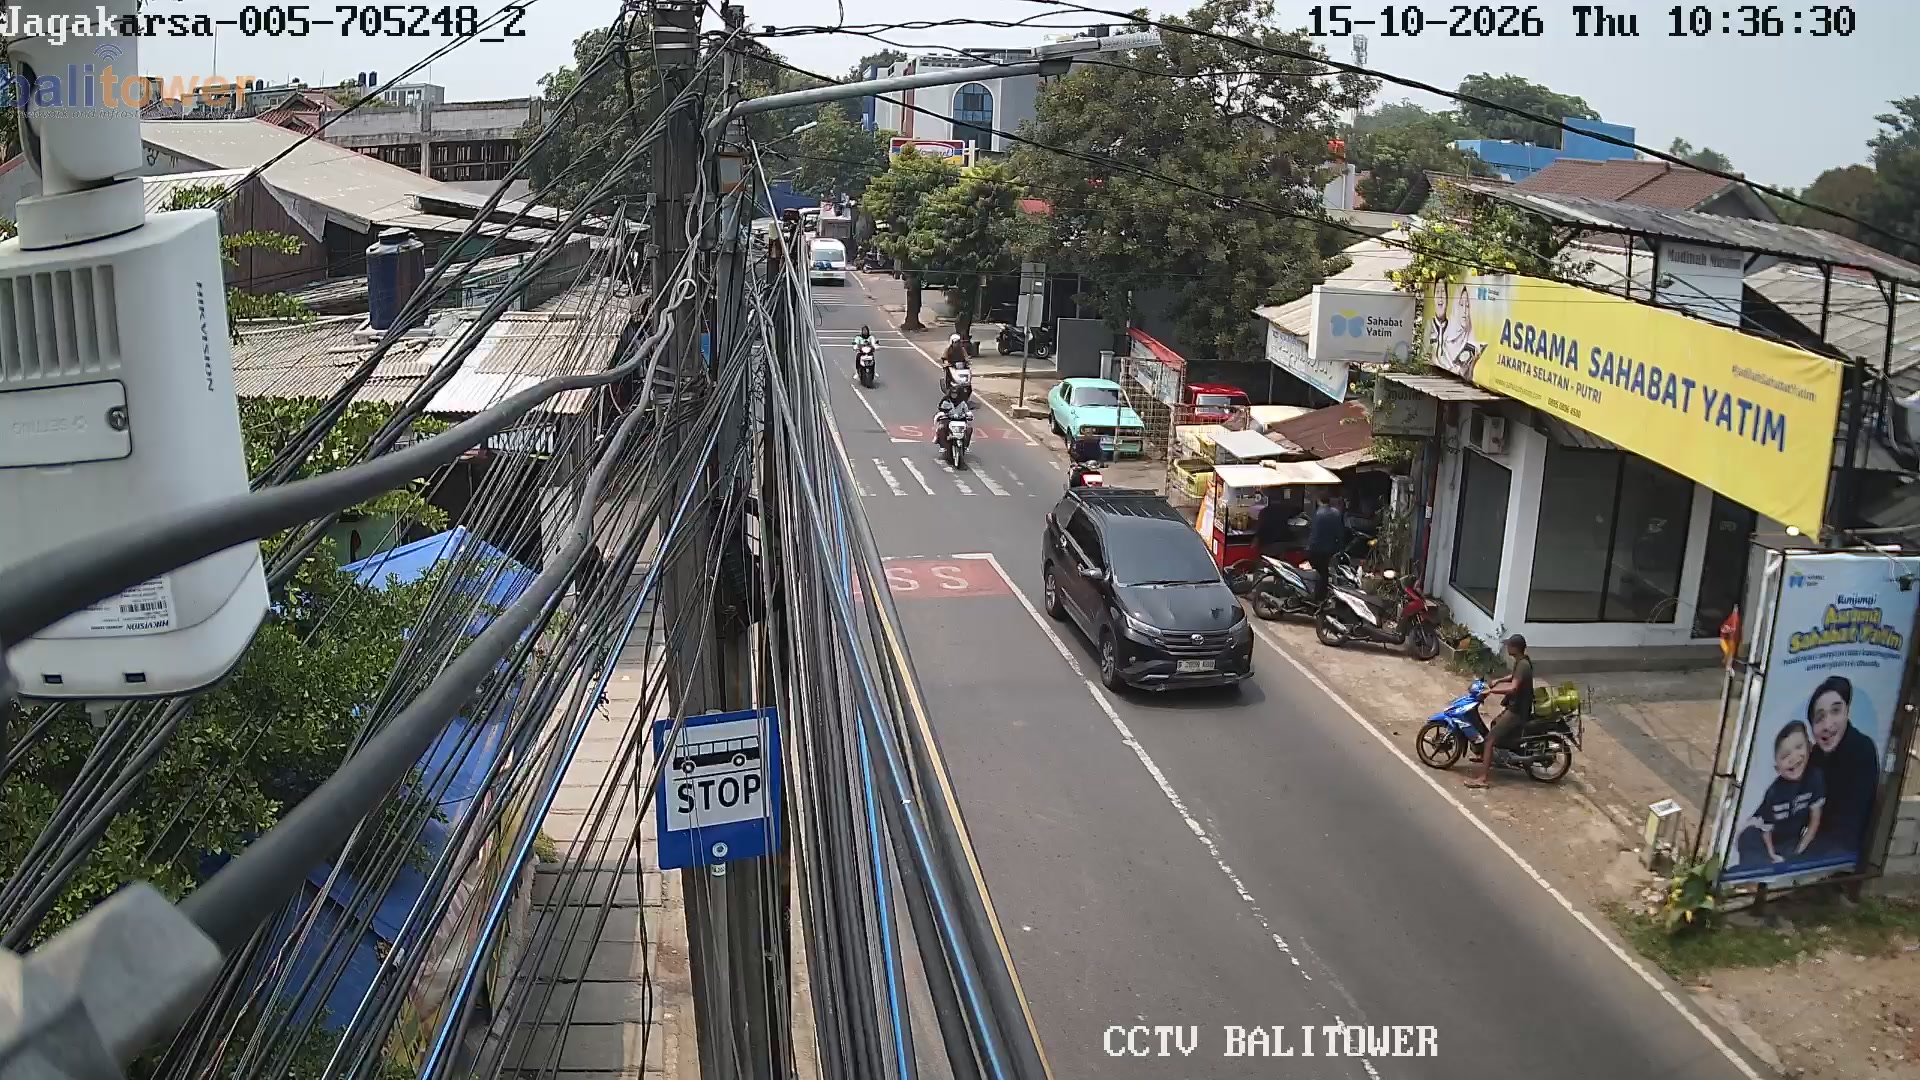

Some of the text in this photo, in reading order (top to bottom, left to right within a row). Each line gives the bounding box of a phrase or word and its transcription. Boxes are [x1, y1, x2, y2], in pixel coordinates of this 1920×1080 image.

[195, 280, 214, 392] HIKVISION
[1366, 327, 1392, 338] Yatim
[1367, 316, 1403, 328] Sahabat
[1497, 353, 1532, 376] JAKARTA
[1533, 366, 1570, 391] SELATAN
[1576, 382, 1603, 404] PUTRI
[1500, 318, 1786, 453] ASRAMA SAHABAT YATIM
[125, 619, 169, 632] HIKVISION
[677, 773, 761, 814] STOP
